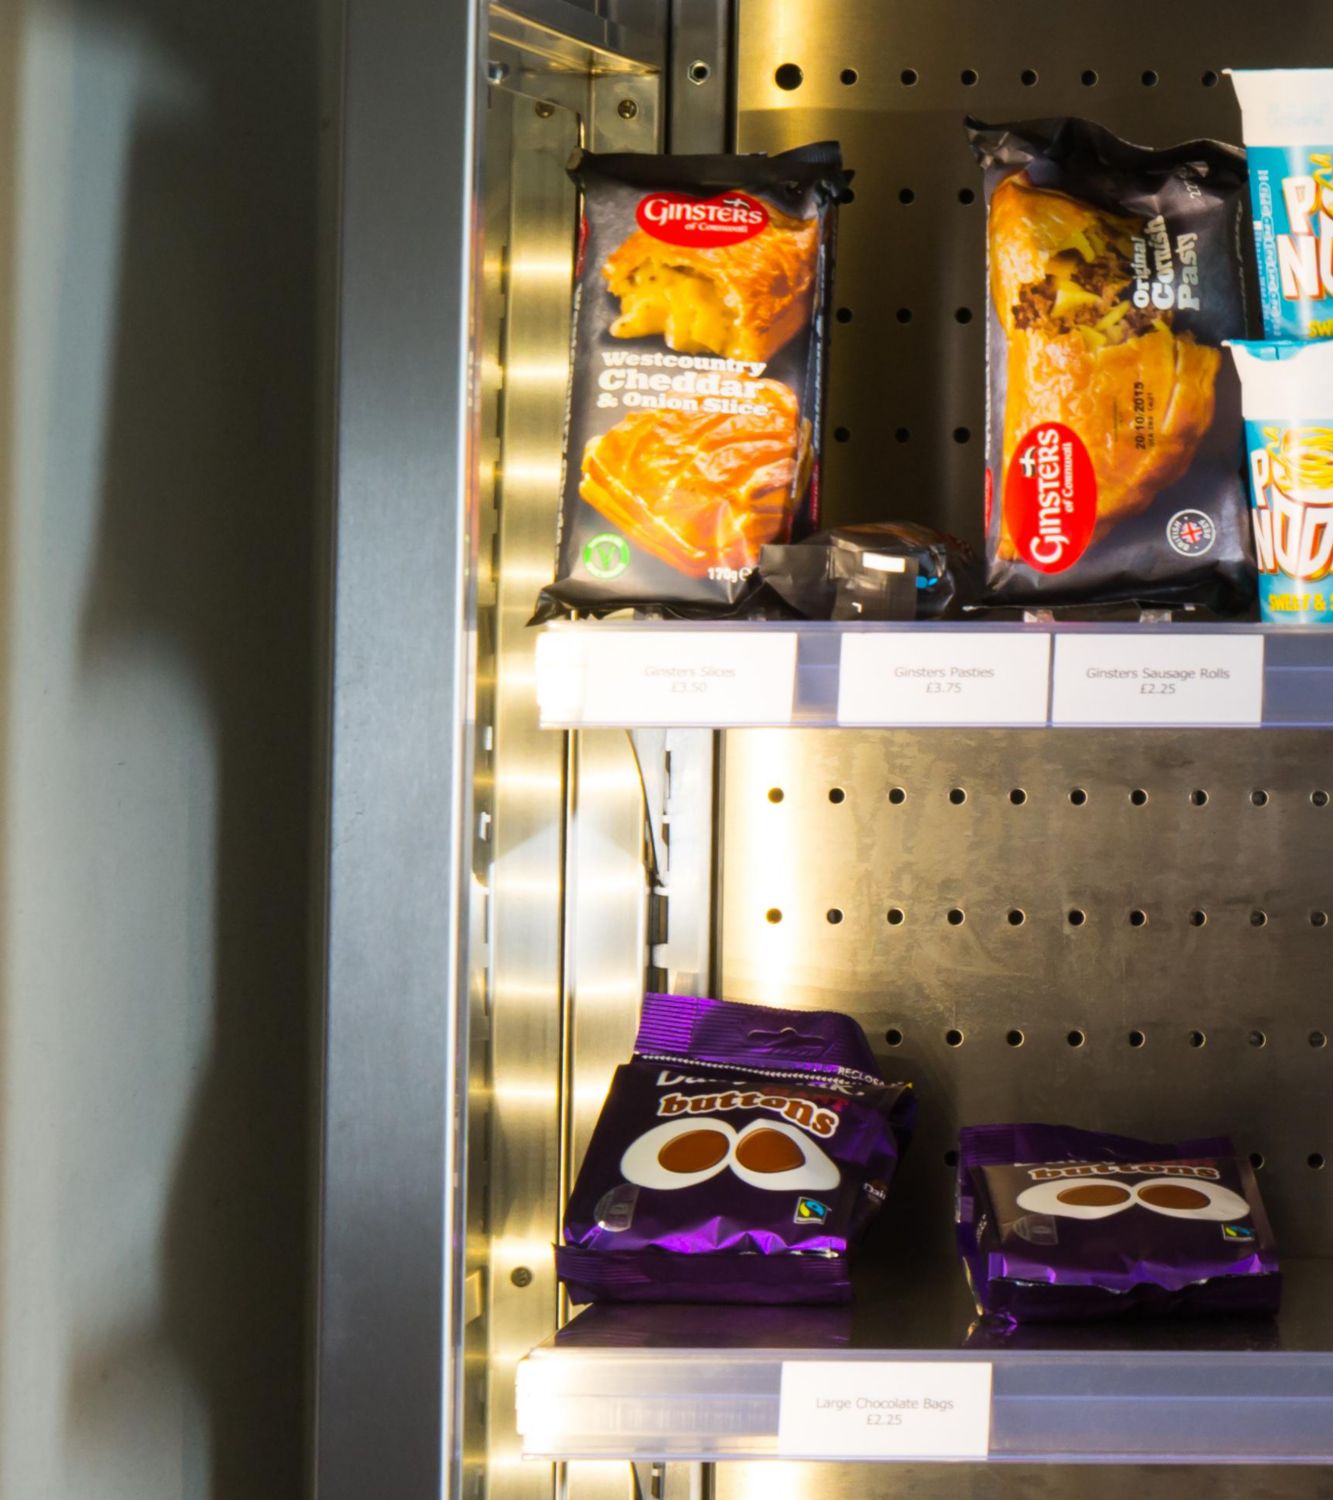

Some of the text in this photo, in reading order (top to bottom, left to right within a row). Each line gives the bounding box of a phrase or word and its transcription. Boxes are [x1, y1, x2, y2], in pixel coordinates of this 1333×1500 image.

[1131, 237, 1150, 309] Original
[1146, 215, 1176, 311] Cornish
[1176, 231, 1201, 312] Pasty
[602, 352, 767, 377] Westcountry
[599, 367, 766, 397] Cheddar
[597, 392, 769, 417] & Onion Slice
[1133, 382, 1146, 450] 20/10/2015
[894, 666, 995, 679] Ginsters Pasties
[1086, 668, 1231, 682] Ginsters Sausage Rolls
[926, 682, 963, 694] £3.75
[1140, 684, 1177, 696] £2.25
[656, 1090, 840, 1139] buttons
[1027, 1164, 1220, 1181] buttons
[817, 1397, 954, 1412] Large Chocolate Bags
[867, 1414, 903, 1426] £2.25
